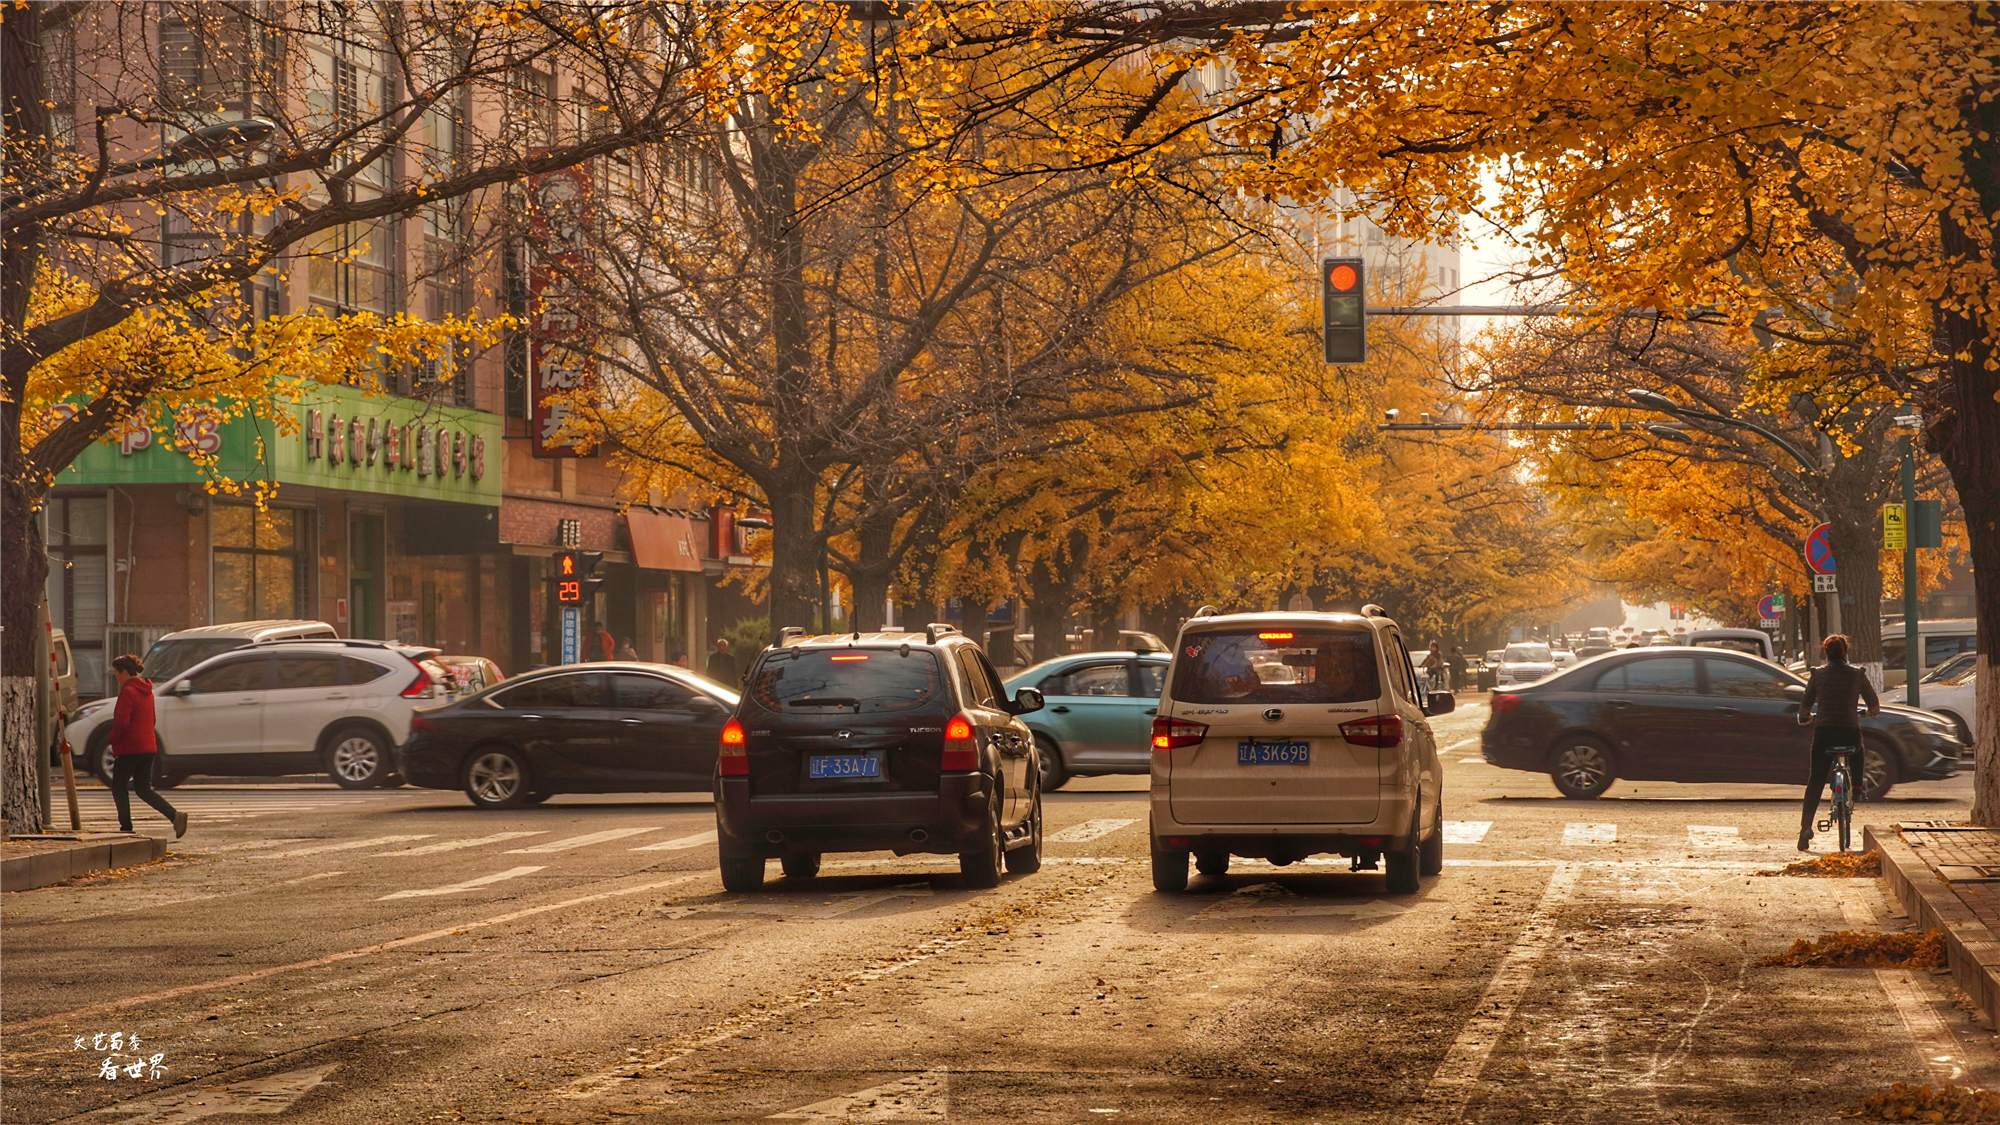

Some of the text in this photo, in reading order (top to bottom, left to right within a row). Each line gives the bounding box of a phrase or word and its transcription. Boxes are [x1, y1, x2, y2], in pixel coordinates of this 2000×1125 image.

[308, 408, 485, 482] 丹东市少年儿童图书馆
[559, 581, 579, 600] 29
[564, 611, 575, 665] 请您看信号通
